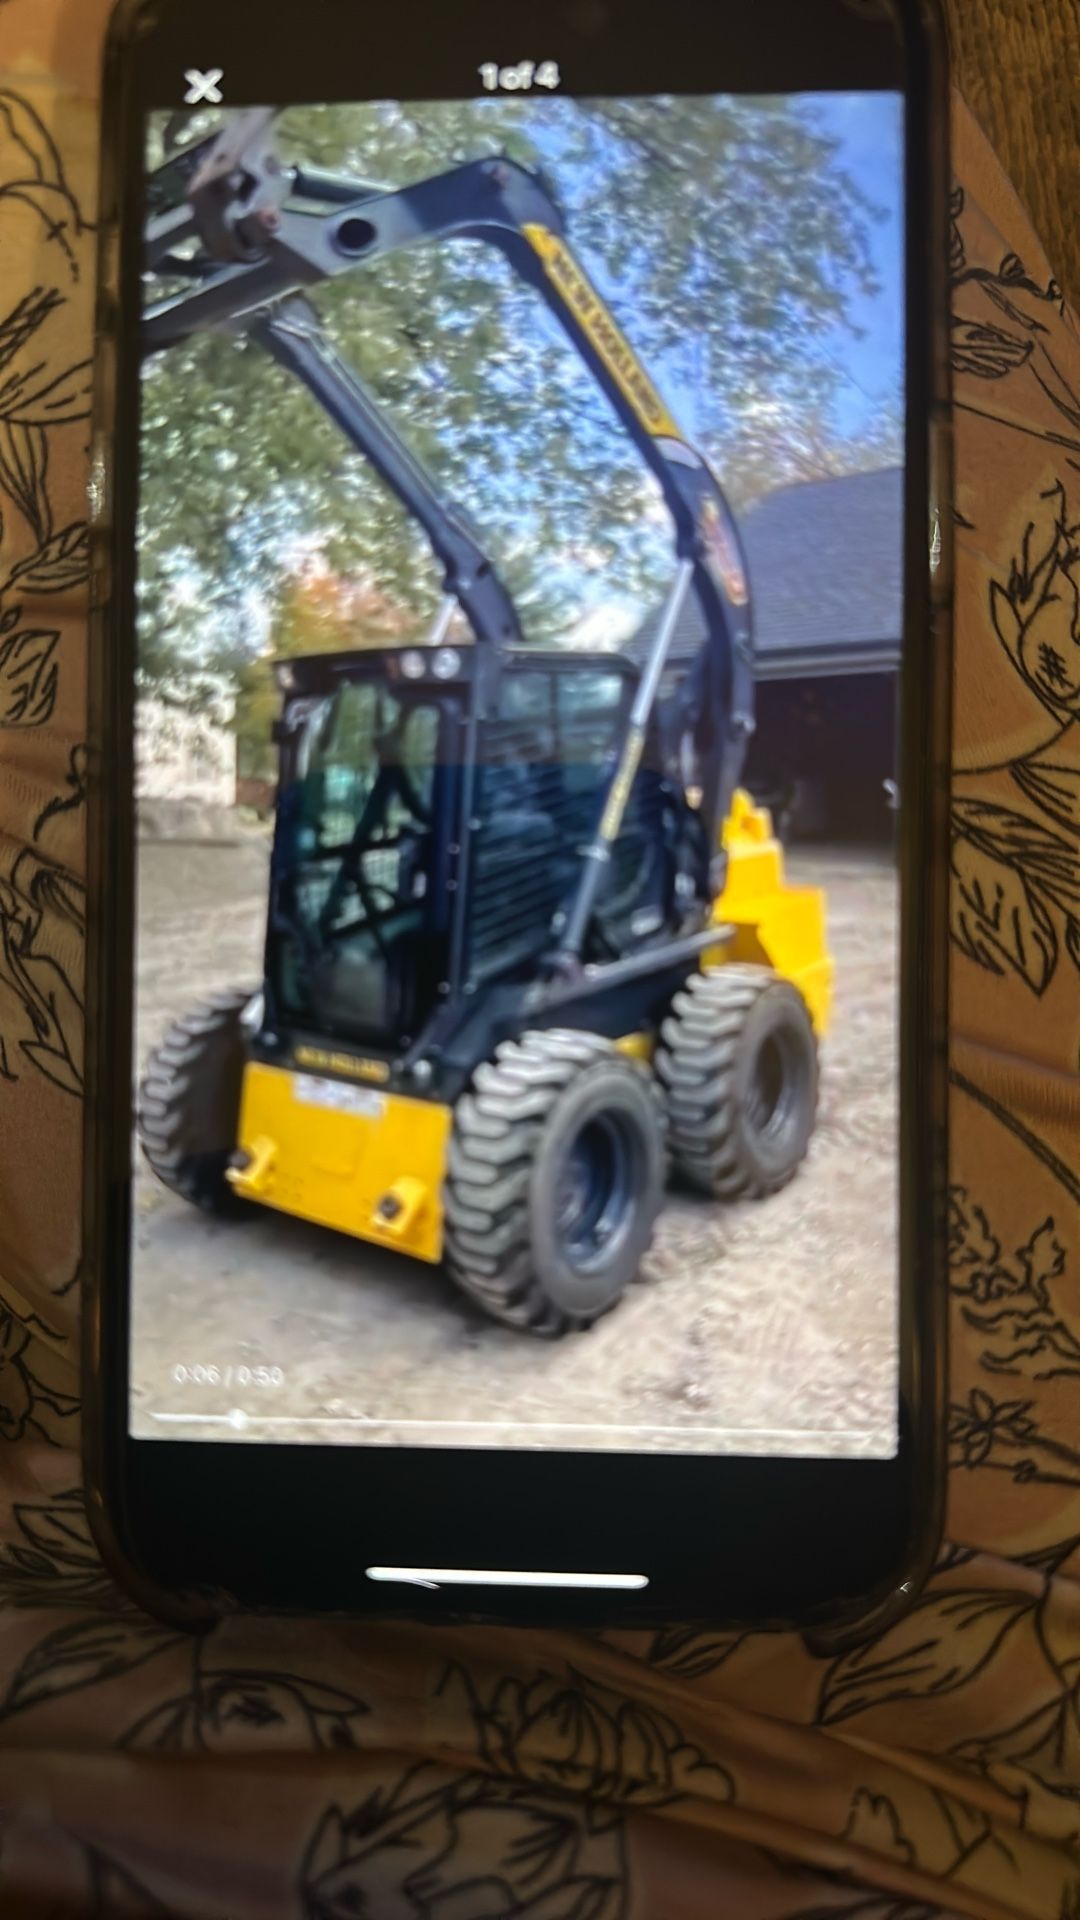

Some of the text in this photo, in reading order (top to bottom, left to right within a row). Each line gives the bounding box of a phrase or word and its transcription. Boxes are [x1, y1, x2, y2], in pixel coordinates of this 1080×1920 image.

[479, 60, 560, 90] 1 of 4
